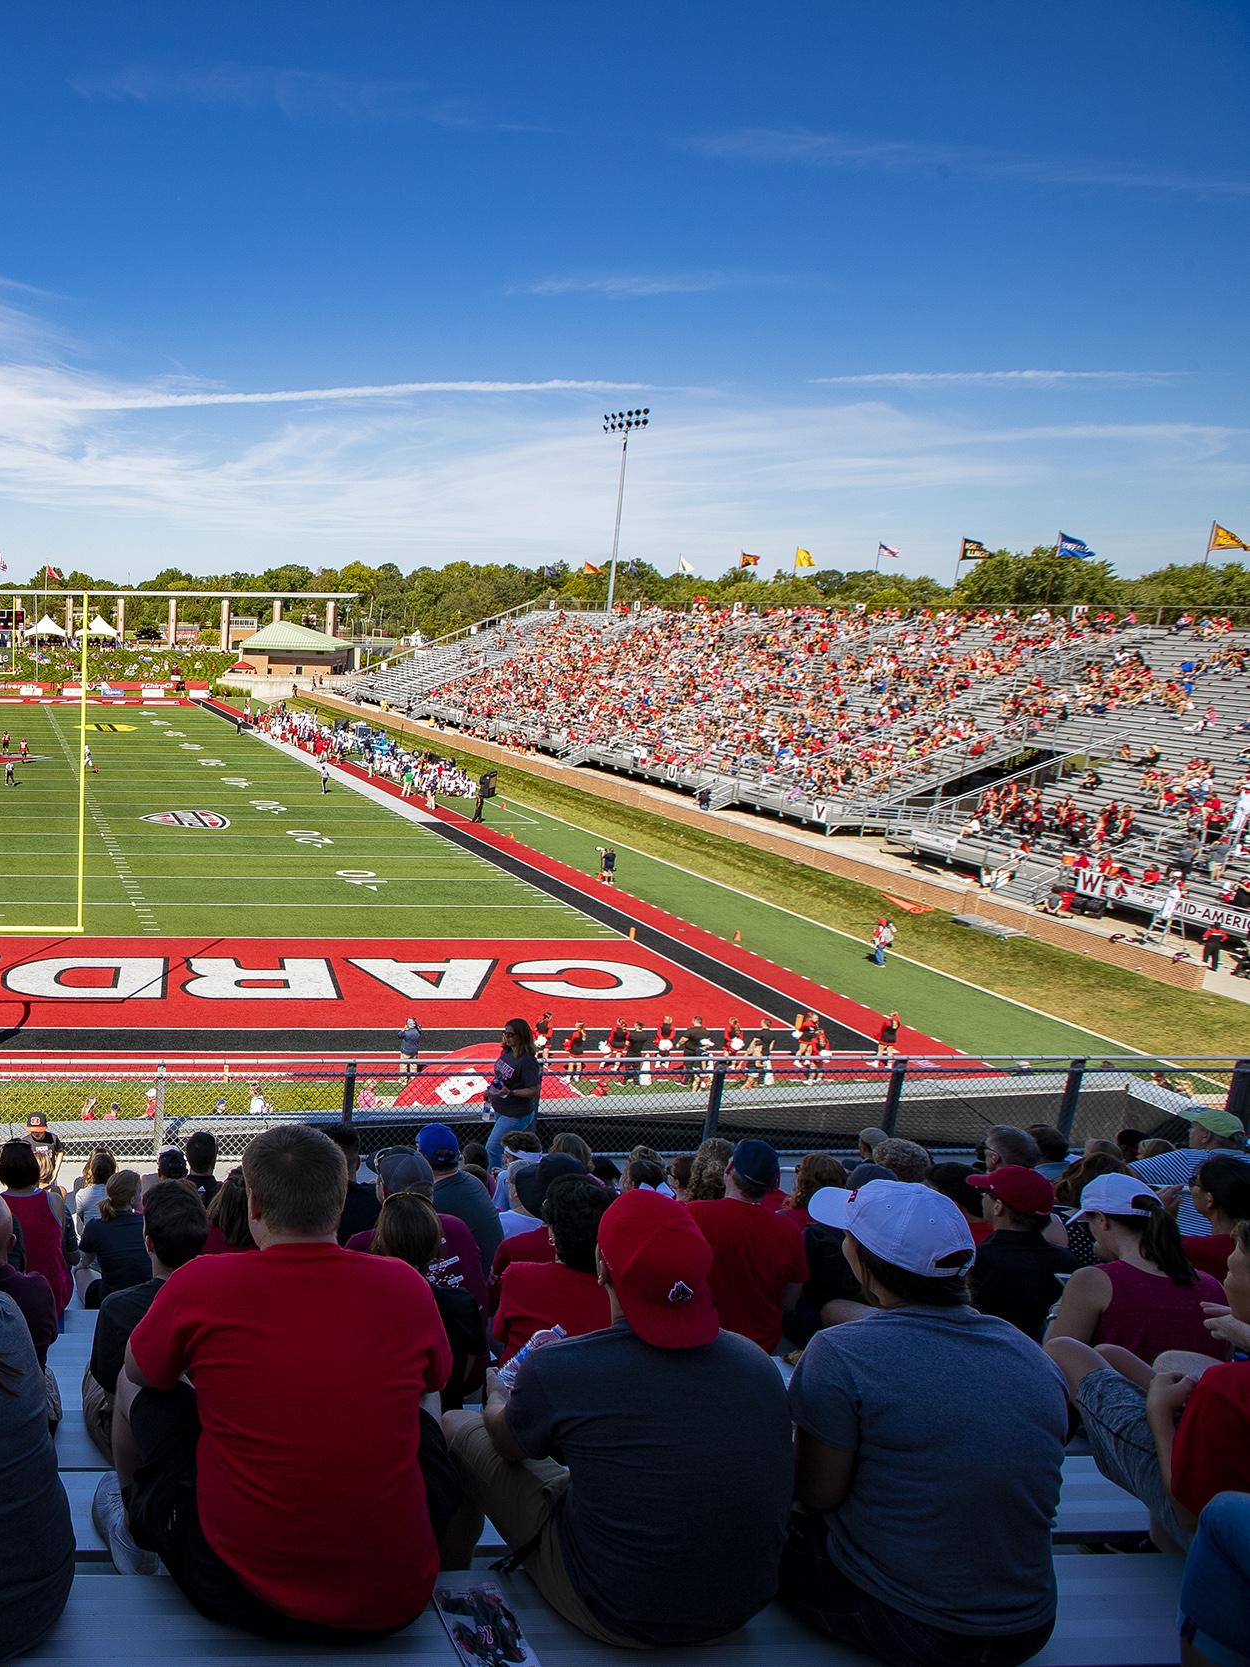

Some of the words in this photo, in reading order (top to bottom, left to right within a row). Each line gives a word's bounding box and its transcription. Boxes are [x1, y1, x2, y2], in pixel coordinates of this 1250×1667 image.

[285, 829, 335, 845] 20
[335, 869, 388, 885] 10
[1081, 871, 1101, 894] W
